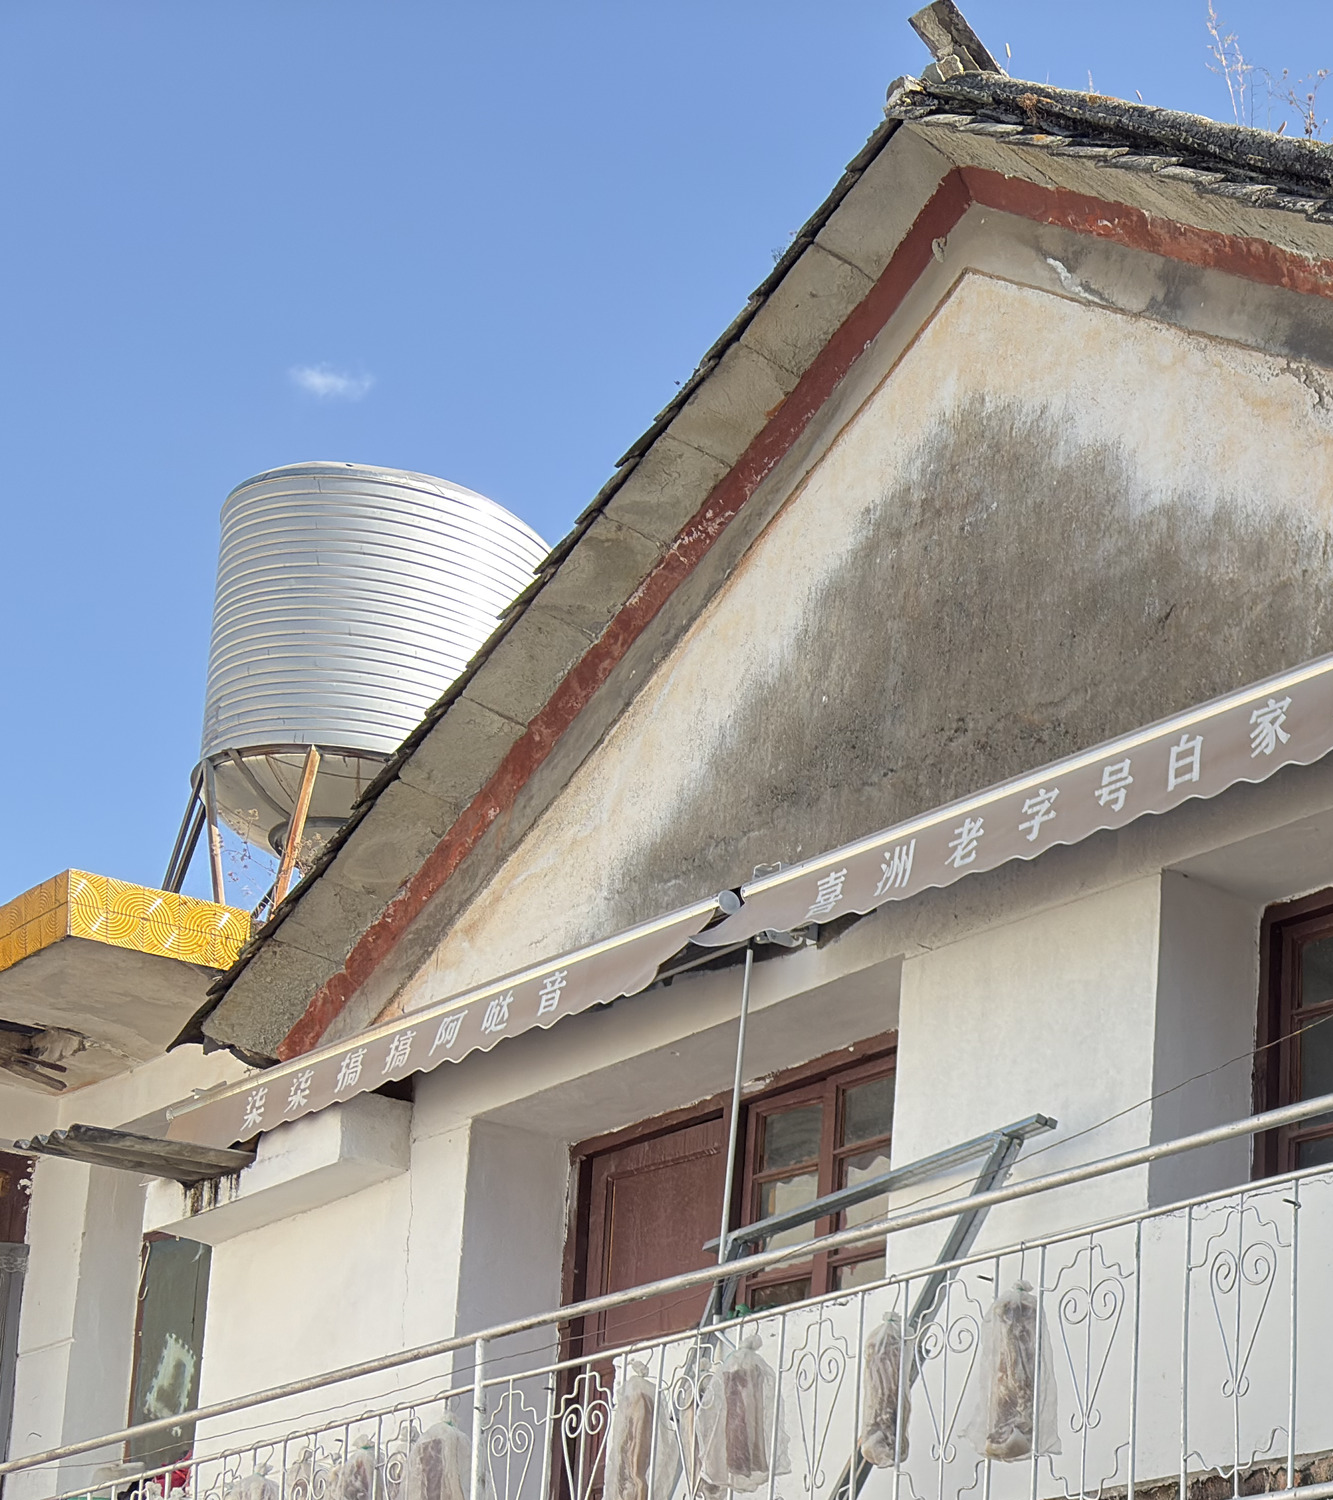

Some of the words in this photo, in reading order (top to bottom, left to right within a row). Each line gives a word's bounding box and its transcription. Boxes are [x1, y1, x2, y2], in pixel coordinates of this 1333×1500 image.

[240, 970, 568, 1132] 柒柒搞搞阿哒音
